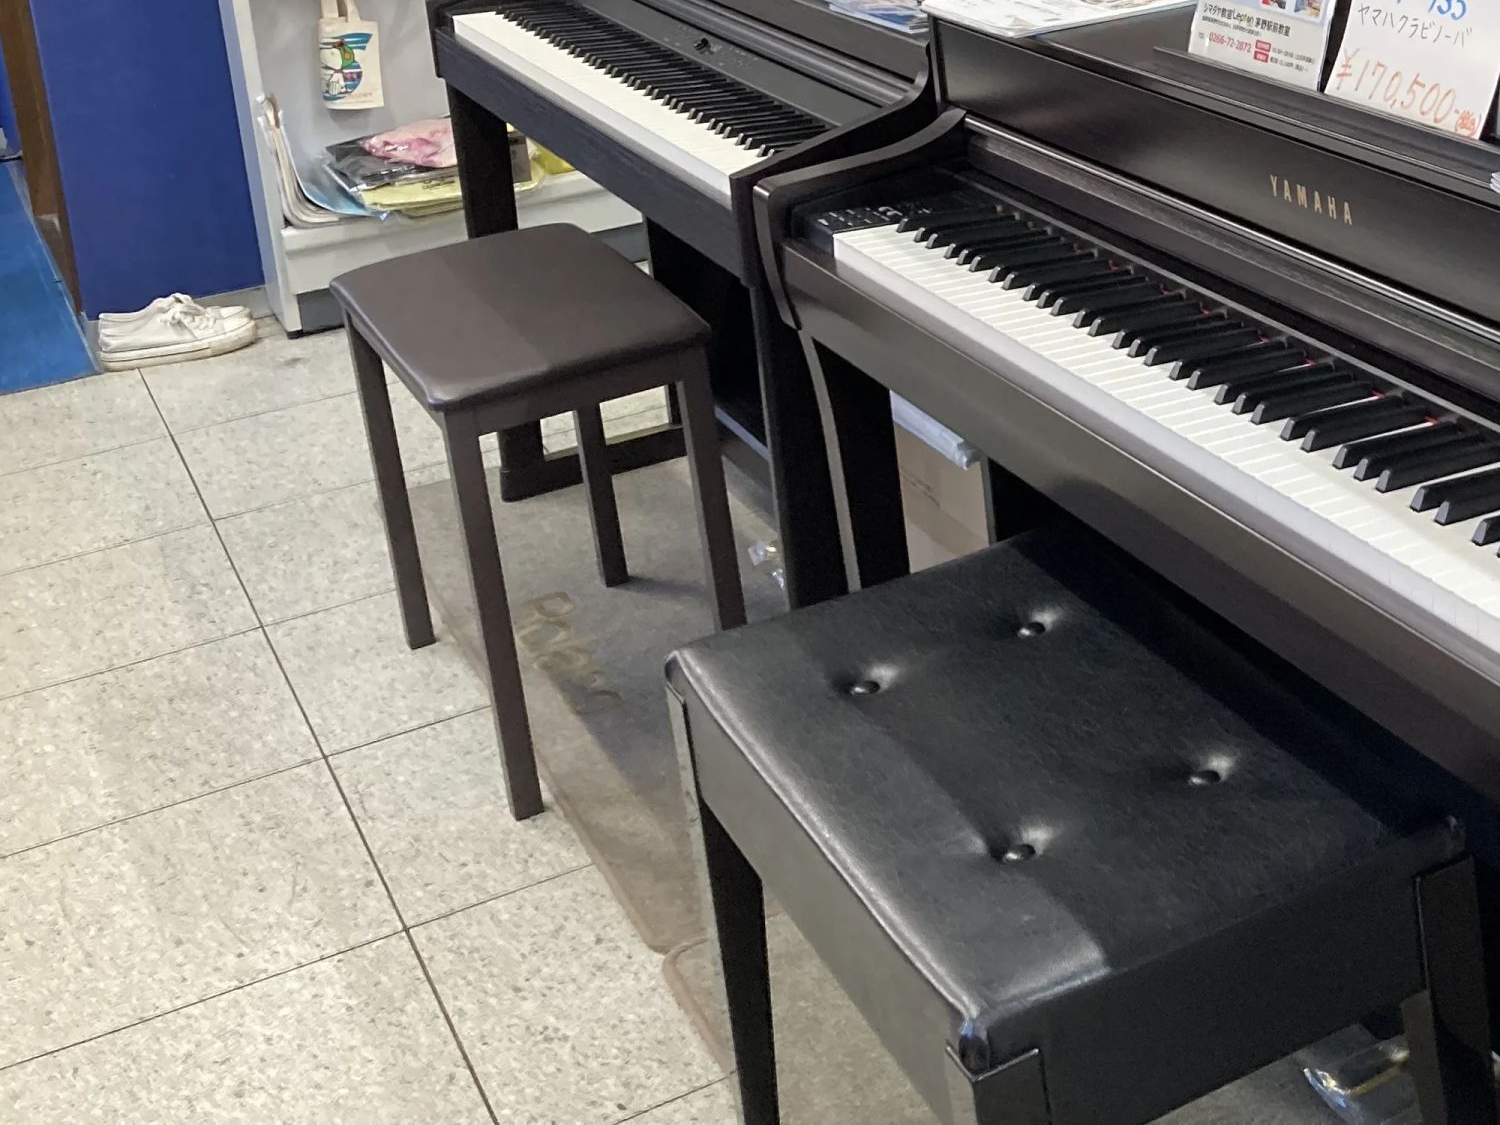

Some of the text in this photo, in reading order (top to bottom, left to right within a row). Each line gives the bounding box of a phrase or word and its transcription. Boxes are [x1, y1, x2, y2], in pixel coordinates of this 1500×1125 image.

[1357, 3, 1474, 48] ヤマハクラビノーバ
[1269, 173, 1354, 227] YAMAHA
